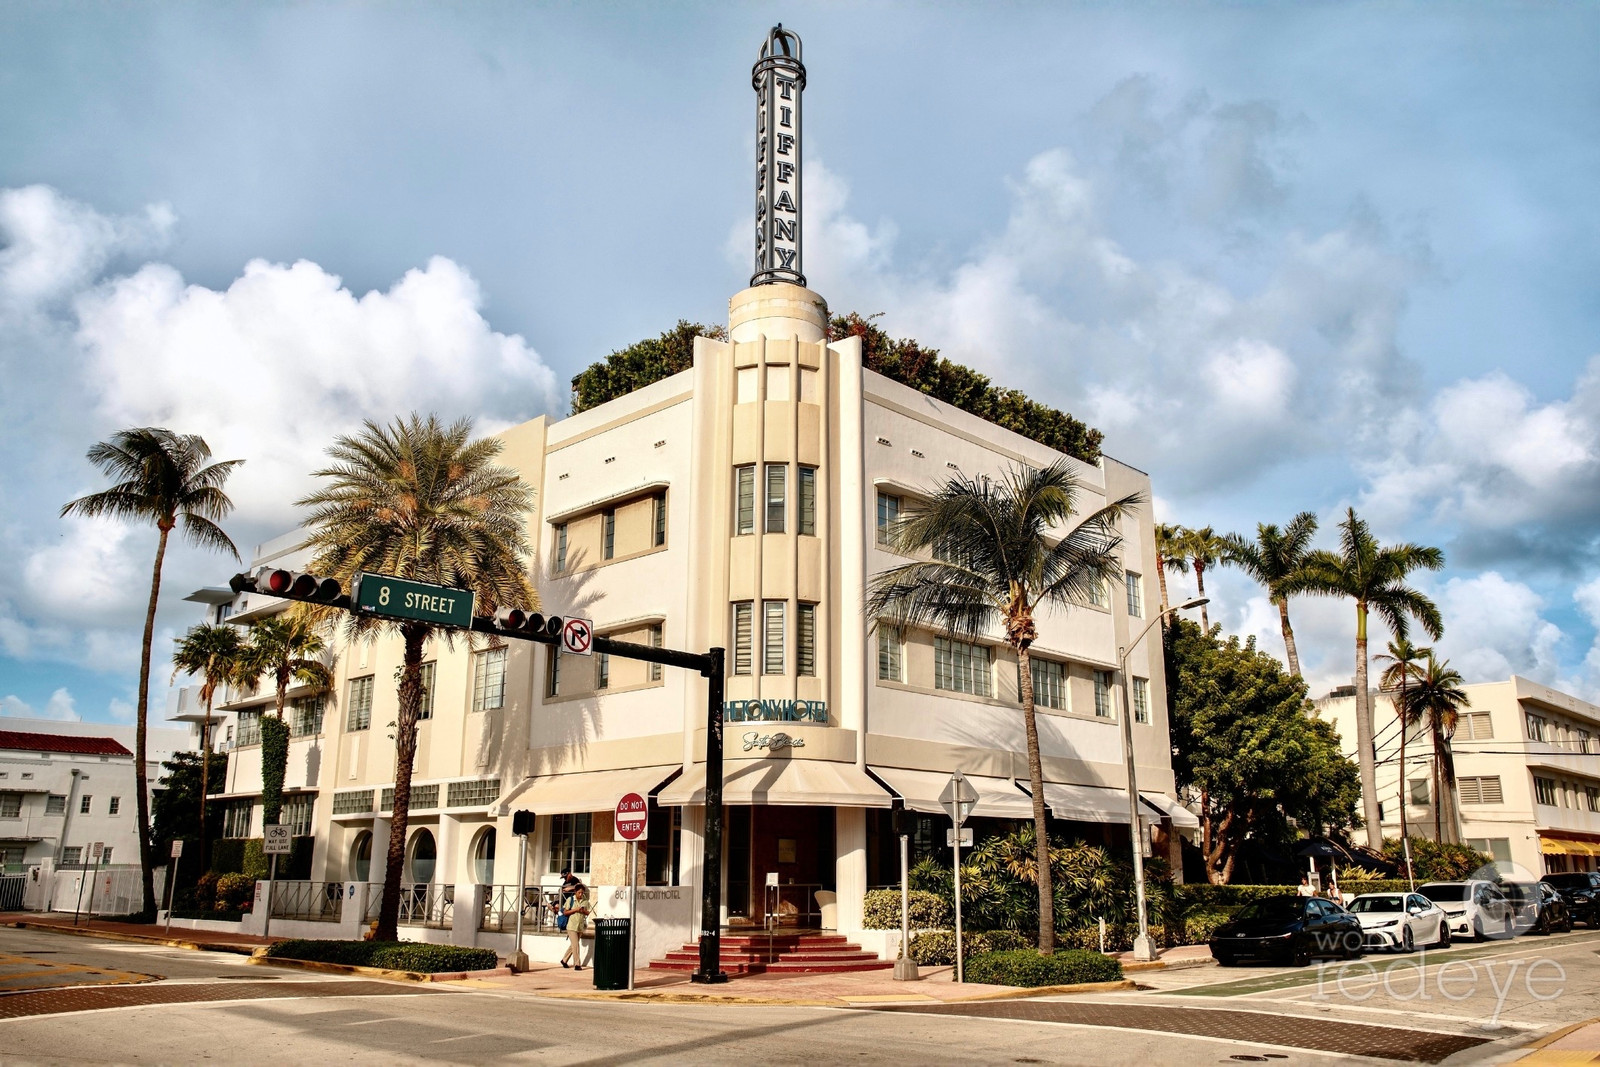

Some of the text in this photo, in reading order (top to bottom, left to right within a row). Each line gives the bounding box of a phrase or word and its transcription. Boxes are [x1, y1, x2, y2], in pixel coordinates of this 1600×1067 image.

[774, 77, 797, 269] TIFFANY
[378, 586, 456, 614] 8 STREET
[723, 699, 828, 723] HE TONY HOTEL
[743, 731, 771, 751] South
[620, 801, 643, 810] DO NOT
[621, 822, 641, 831] ENTER
[615, 889, 627, 900] 801
[661, 890, 681, 900] HOTEL
